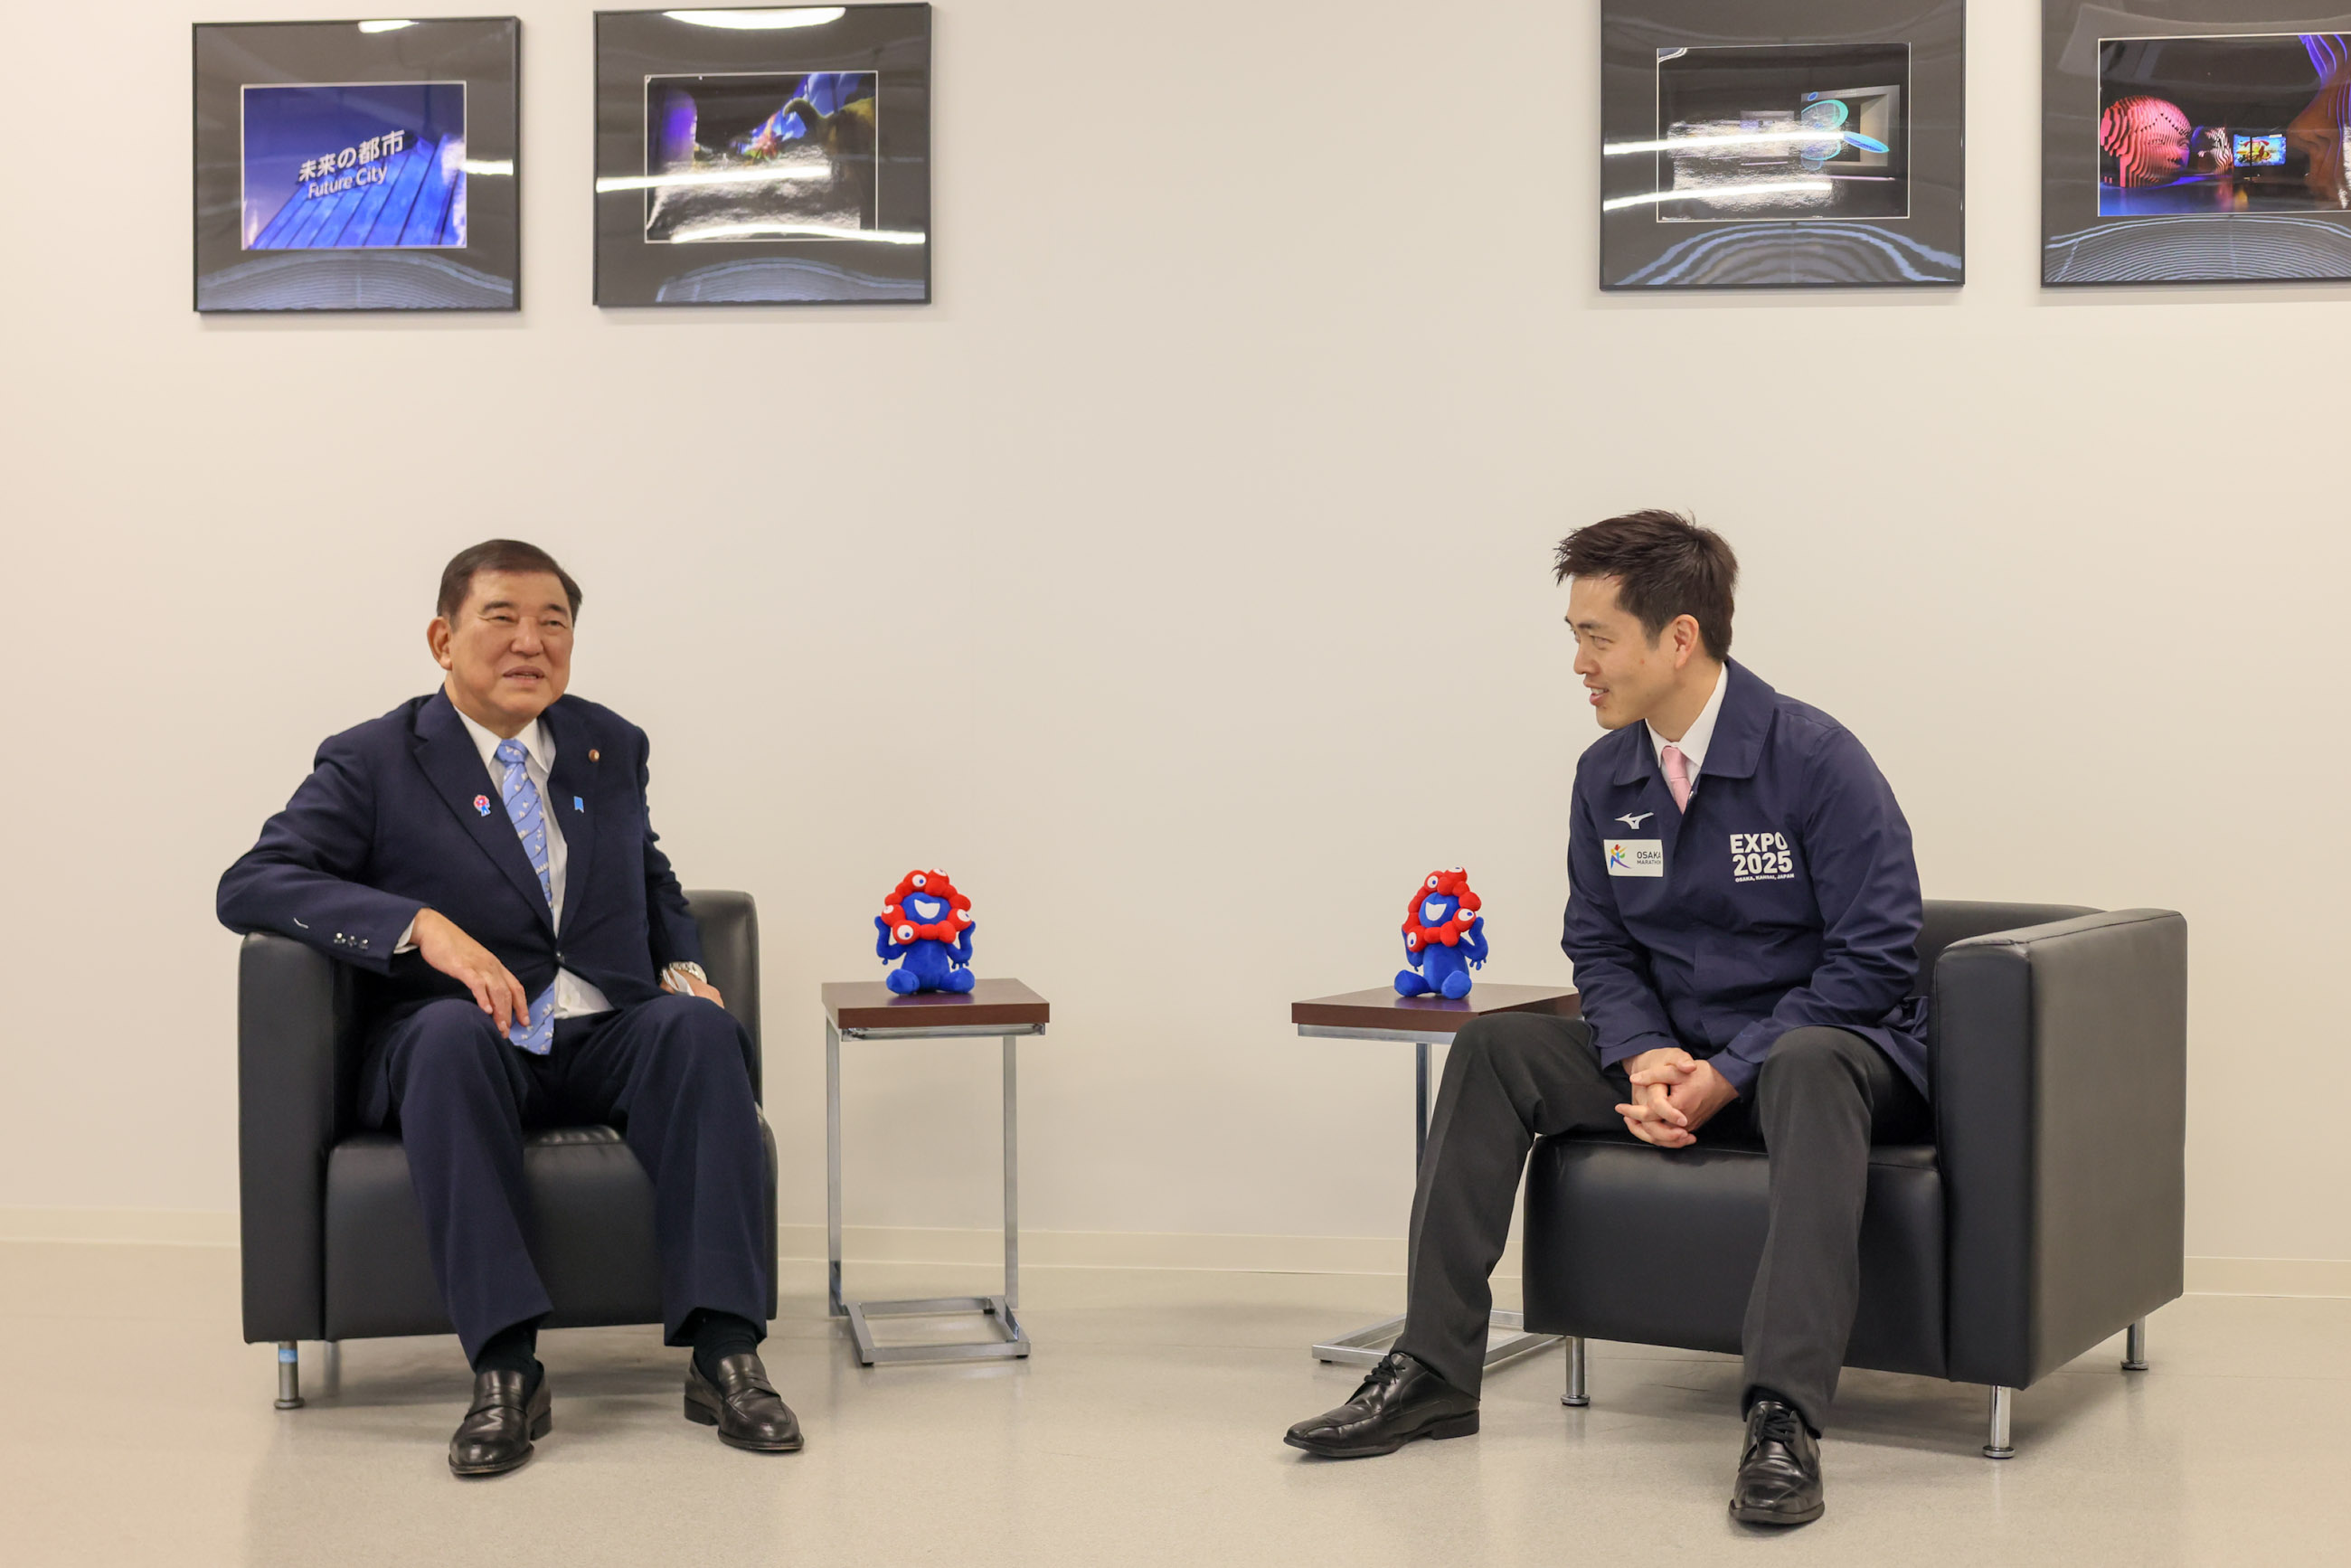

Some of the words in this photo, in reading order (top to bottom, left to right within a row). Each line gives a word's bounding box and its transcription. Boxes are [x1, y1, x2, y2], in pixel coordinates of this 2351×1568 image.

[298, 129, 405, 182] 未来の都市
[307, 175, 354, 199] Future
[355, 165, 388, 186] City
[1637, 851, 1661, 859] OSAKA
[1730, 832, 1789, 854] EXPO
[1733, 850, 1793, 876] 2025
